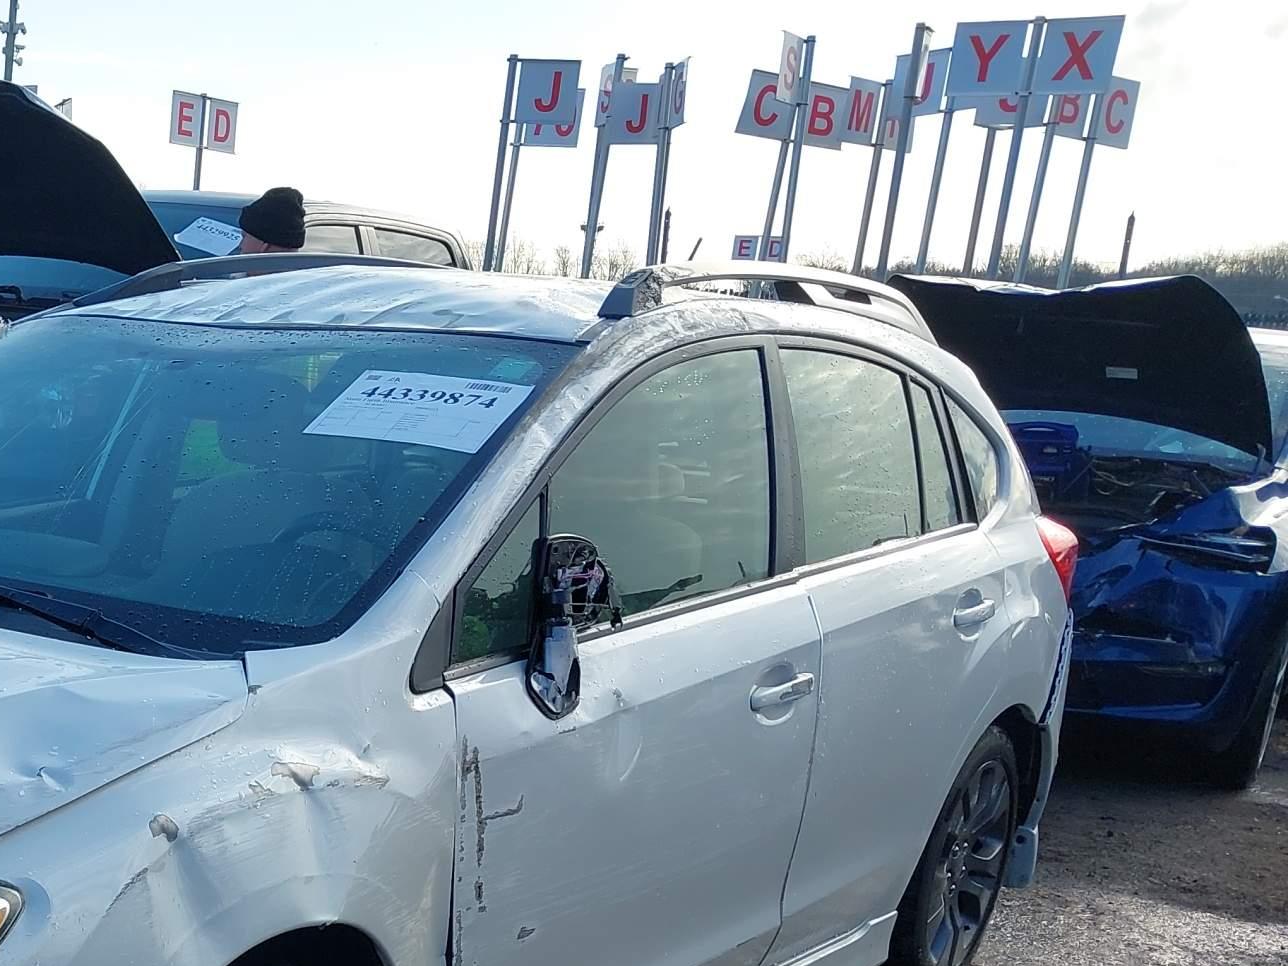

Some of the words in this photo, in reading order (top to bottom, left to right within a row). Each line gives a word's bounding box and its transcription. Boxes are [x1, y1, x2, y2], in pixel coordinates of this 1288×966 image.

[784, 46, 798, 91] S
[970, 34, 1010, 82] Y
[1052, 31, 1103, 80] X
[535, 71, 562, 112] J
[753, 84, 778, 127] C
[807, 95, 835, 136] B
[847, 89, 874, 133] M
[1106, 89, 1129, 134] C
[177, 101, 194, 137] E
[213, 108, 231, 143] D
[626, 94, 648, 134] J
[738, 239, 753, 257] E
[361, 386, 499, 409] 44339874
